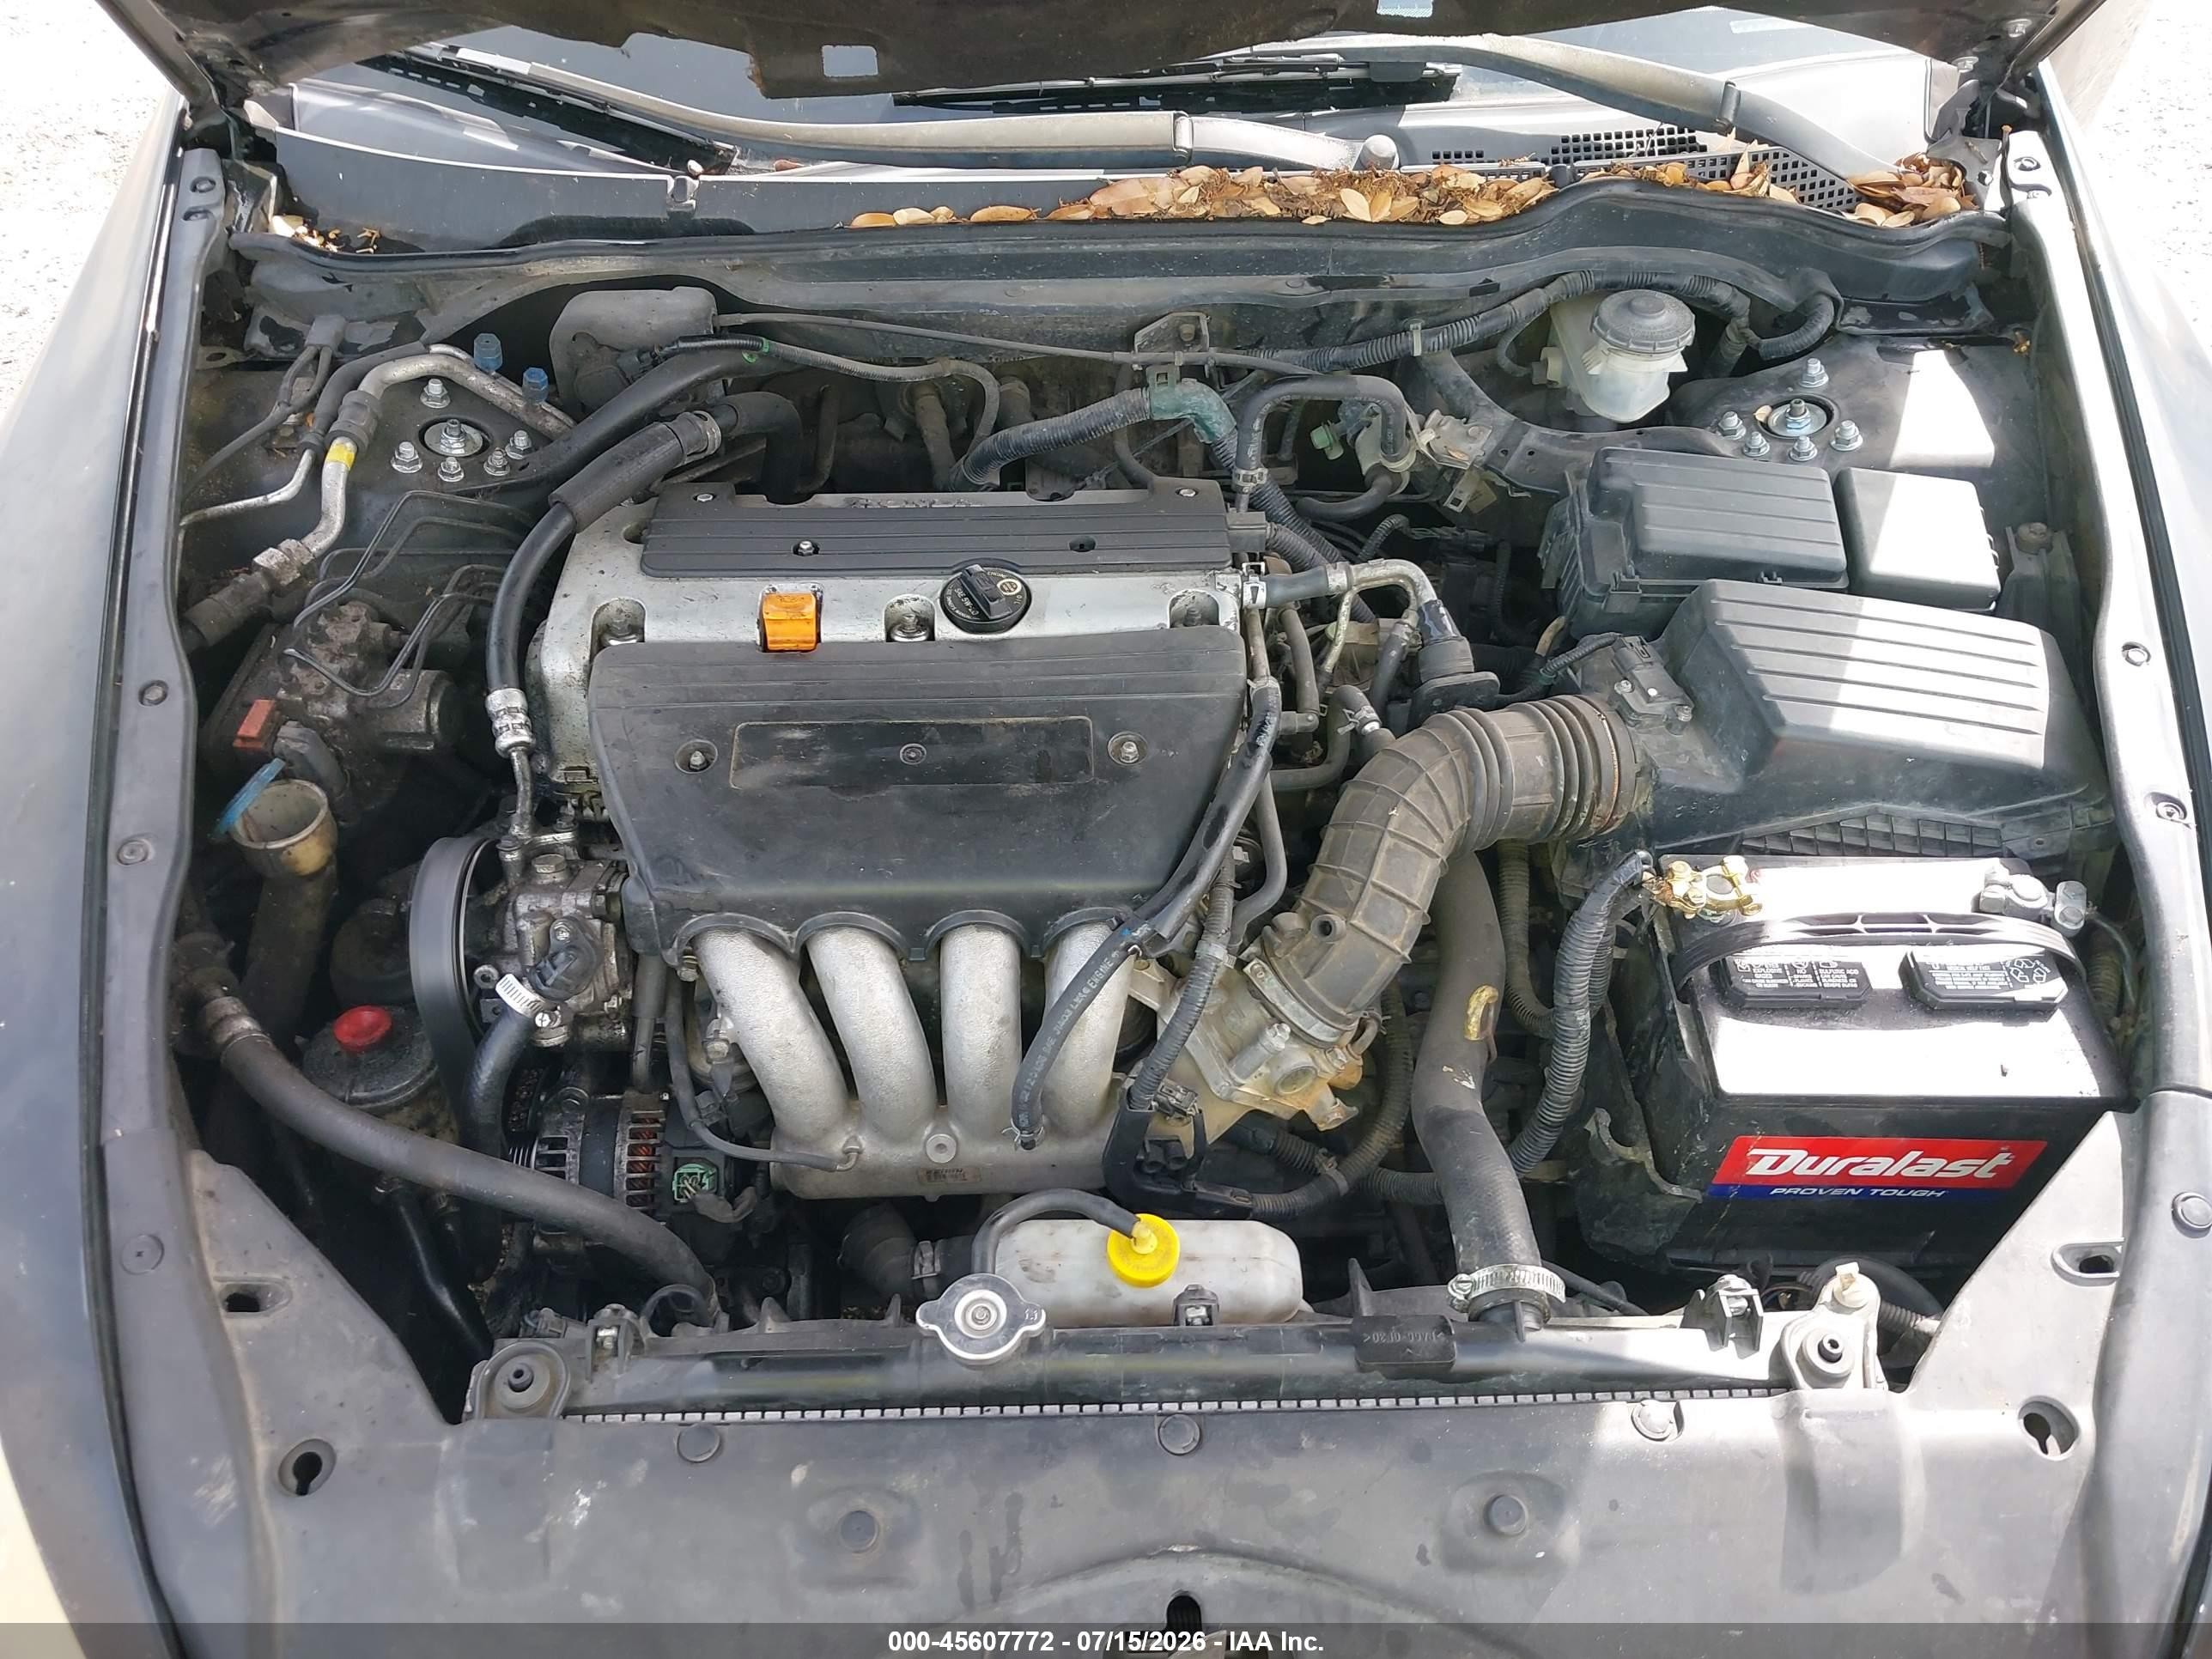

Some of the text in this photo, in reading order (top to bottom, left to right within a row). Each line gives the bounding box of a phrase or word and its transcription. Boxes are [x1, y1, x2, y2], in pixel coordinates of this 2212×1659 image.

[1013, 594, 1023, 605] OIL
[1745, 1148, 2015, 1179] Duralast
[1769, 1188, 1946, 1198] PROVEN TOUGH
